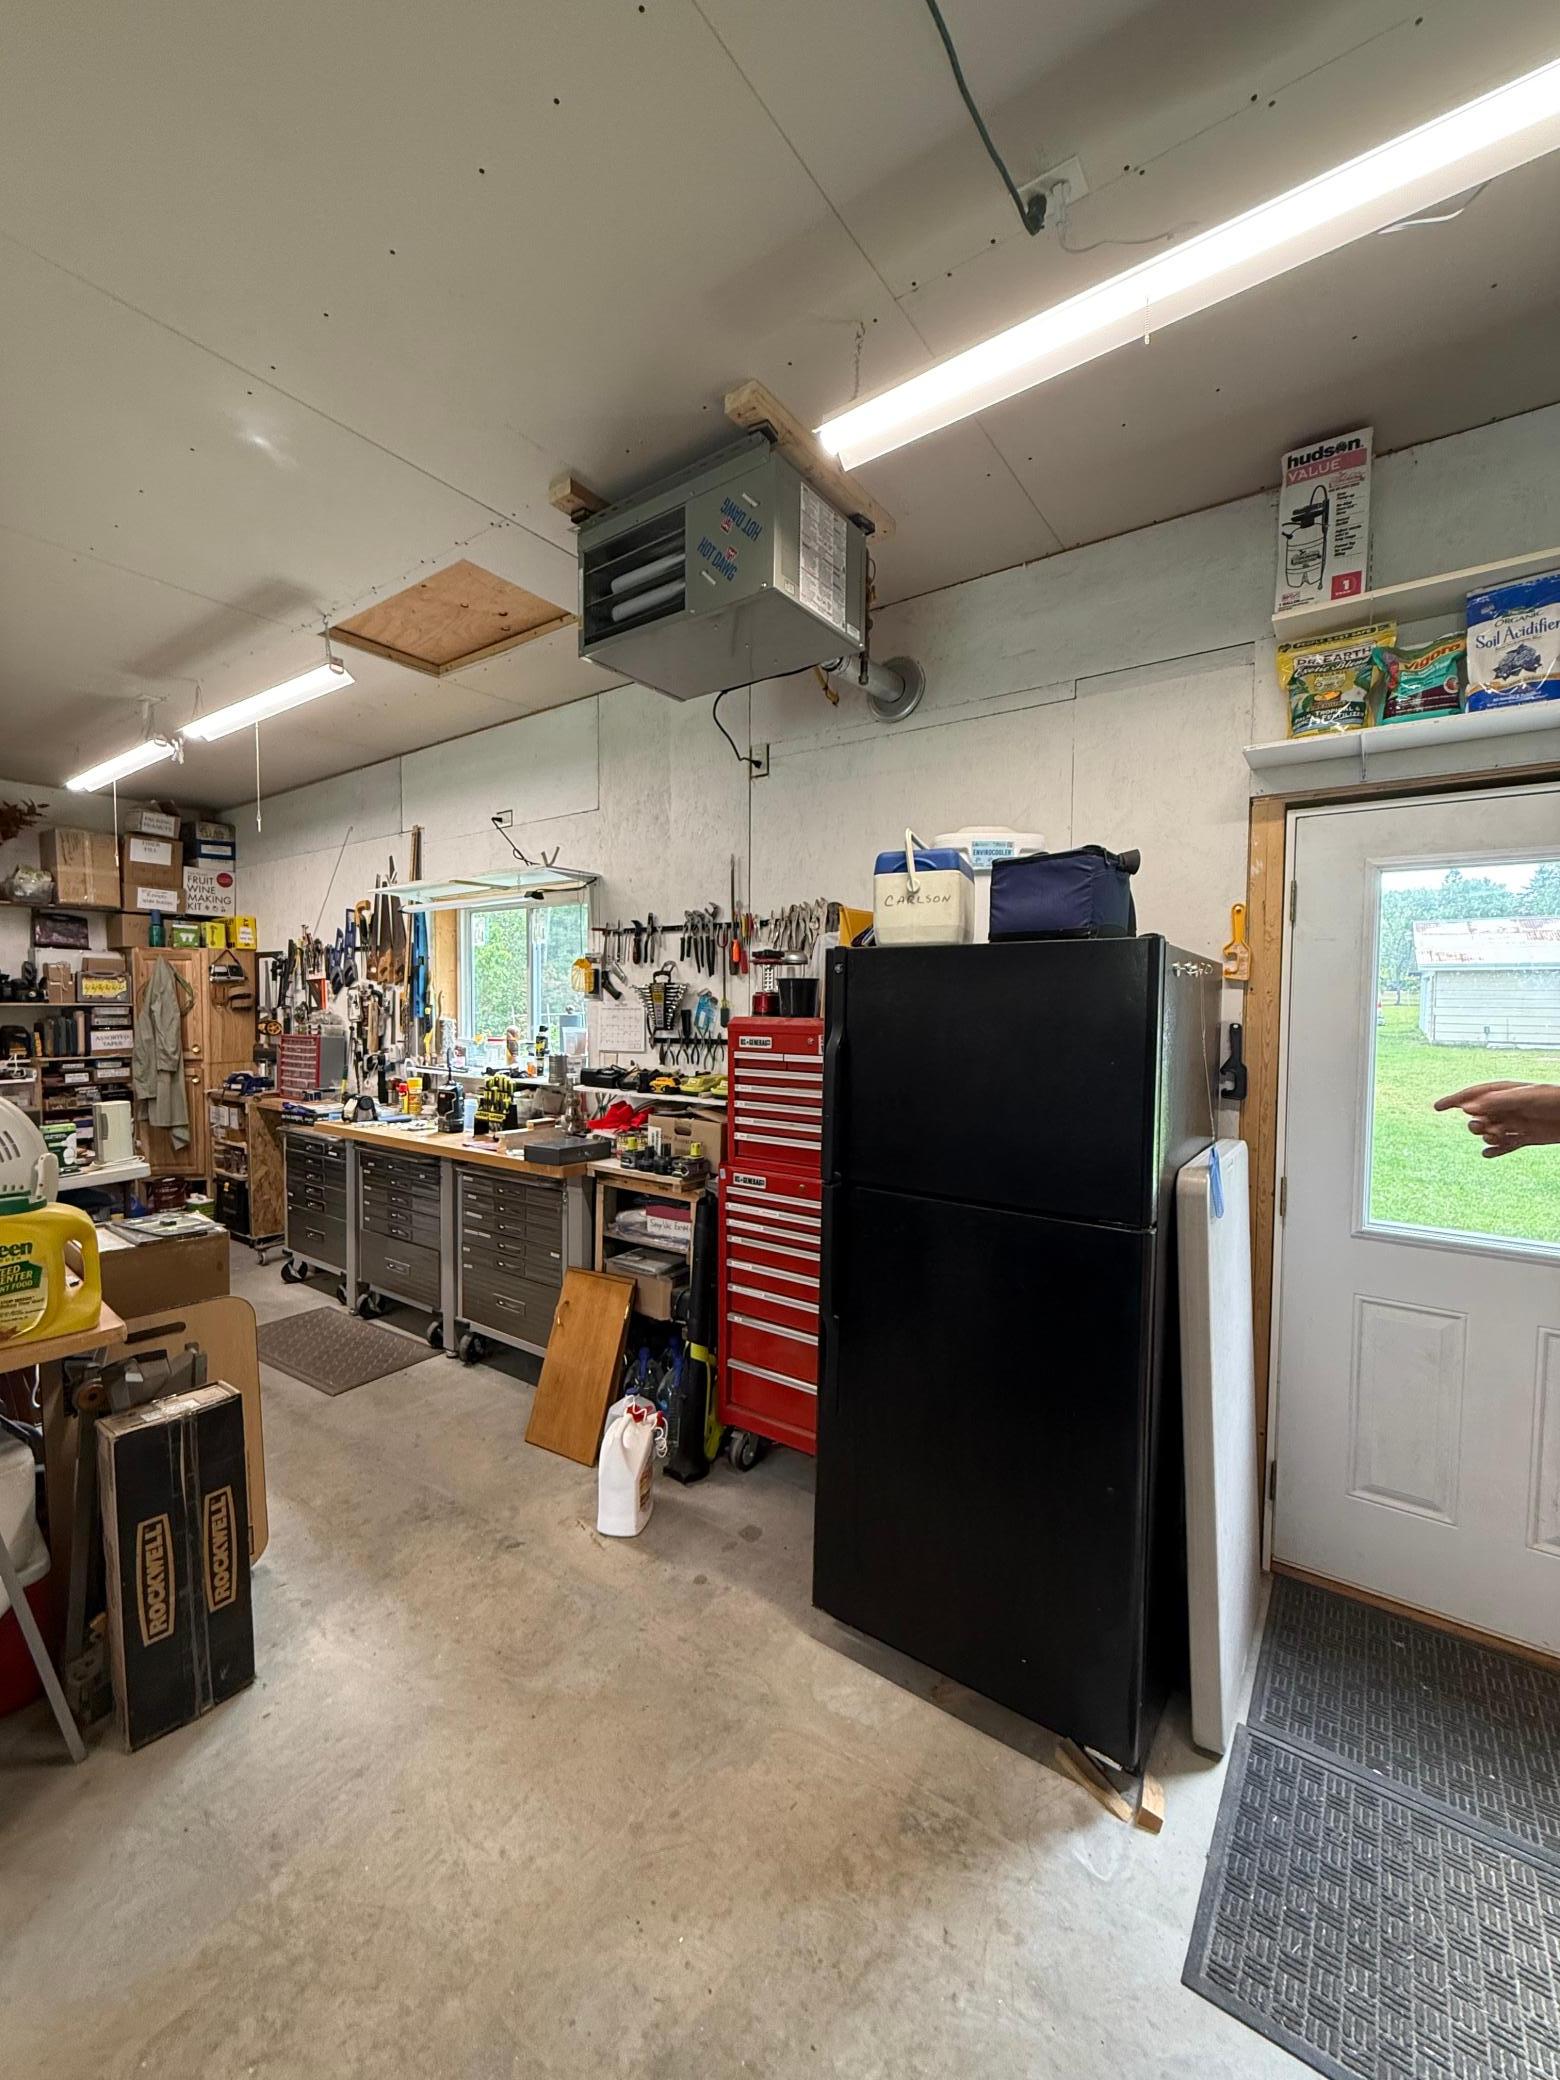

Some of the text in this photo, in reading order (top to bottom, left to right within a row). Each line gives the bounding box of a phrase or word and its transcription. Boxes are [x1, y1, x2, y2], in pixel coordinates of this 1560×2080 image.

[1288, 438, 1361, 469] hudson
[1289, 458, 1341, 482] VALUE
[720, 497, 763, 542] HOT DAWG
[697, 536, 737, 581] HOT DAWG
[1343, 579, 1350, 591] 1
[1494, 610, 1545, 628] ORGANIC
[1475, 630, 1500, 649] Soil
[1503, 617, 1560, 643] Acidifier
[1324, 646, 1372, 663] EARTH
[1404, 643, 1461, 671] Vigoro
[187, 874, 214, 886] FRUIT
[187, 883, 216, 895] WINE
[187, 893, 232, 905] MAKING
[187, 902, 202, 911] KIT
[884, 894, 952, 907] CARLSON
[12, 1280, 33, 1290] FOOD
[210, 1491, 231, 1603] ROCKWELL
[145, 1521, 169, 1637] ROCKWELL
